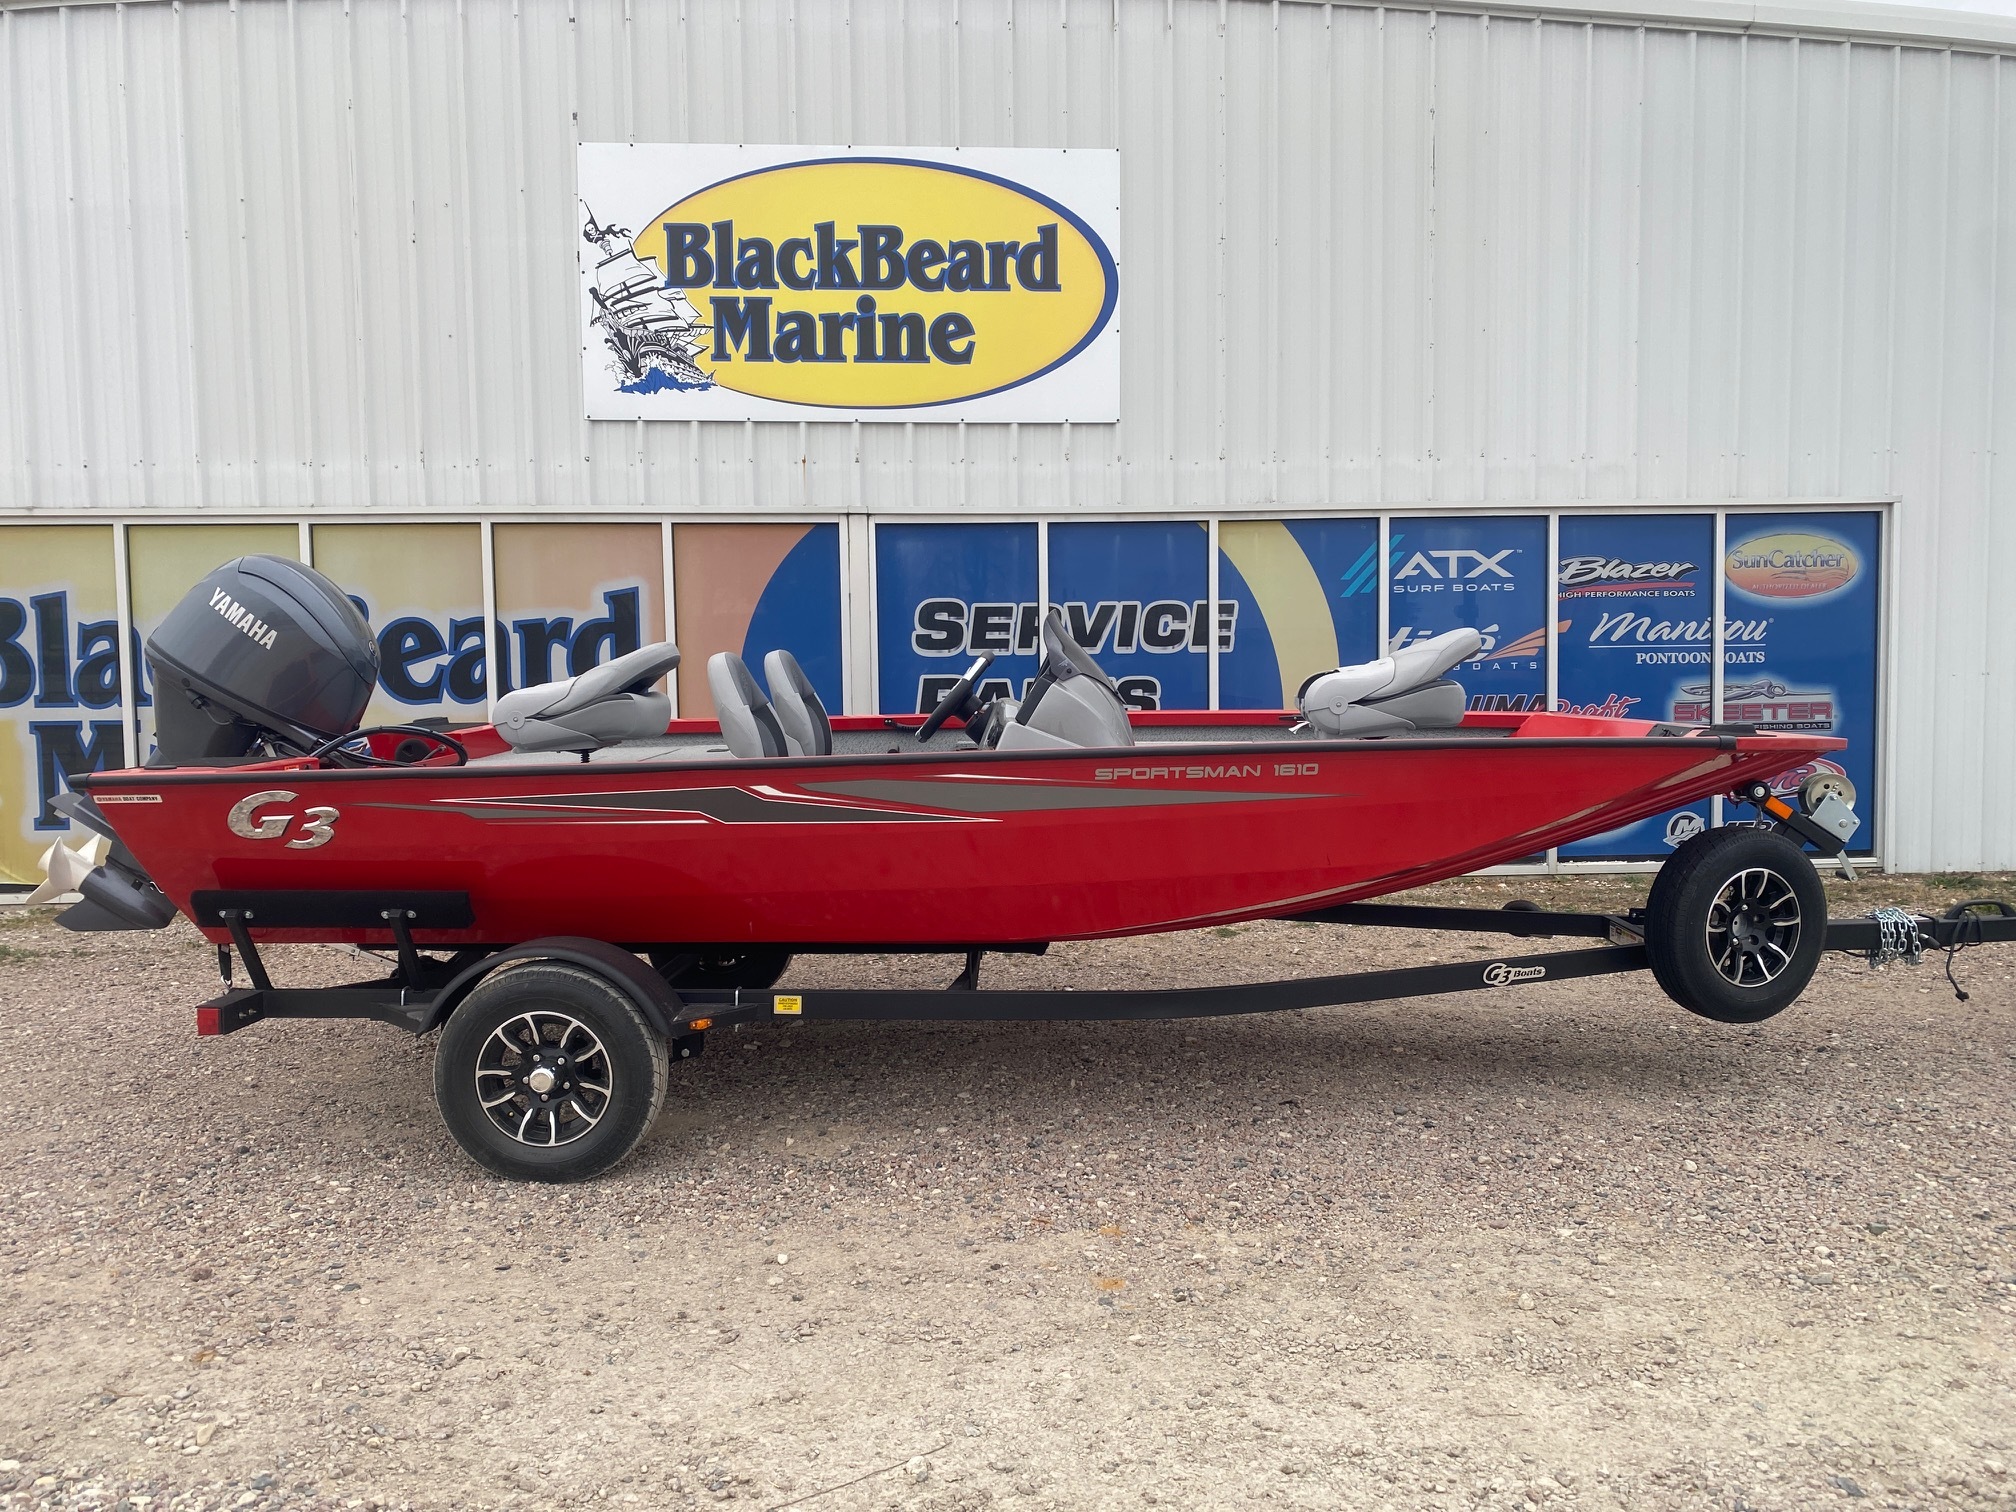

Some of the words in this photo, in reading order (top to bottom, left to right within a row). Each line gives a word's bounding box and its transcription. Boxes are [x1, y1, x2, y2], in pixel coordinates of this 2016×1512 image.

[663, 219, 1061, 292] BlackBeard
[709, 294, 975, 365] Marine
[1394, 549, 1515, 580] ATX
[1558, 556, 1699, 586] Blazer
[1732, 549, 1845, 570] SunCatcher
[1393, 584, 1445, 593] SURF
[1452, 583, 1515, 592] BOATS
[1585, 589, 1660, 598] PERFORMANCE
[1663, 589, 1696, 598] BOATS
[1800, 582, 1828, 590] DEALER
[208, 587, 278, 650] YAMAHA
[911, 598, 1239, 657] SERVICE
[1589, 612, 1768, 642] Maniou
[1636, 651, 1712, 665] PONTOON
[1724, 651, 1766, 664] OATS
[1674, 701, 1833, 721] SKEETER
[1754, 723, 1794, 731] FISHING
[1796, 722, 1831, 730] BOATS
[1094, 765, 1261, 780] SPORTSMAN
[1273, 763, 1320, 777] 1610
[227, 790, 340, 849] G3
[1484, 963, 1513, 986] G3
[1513, 969, 1543, 978] Boats
